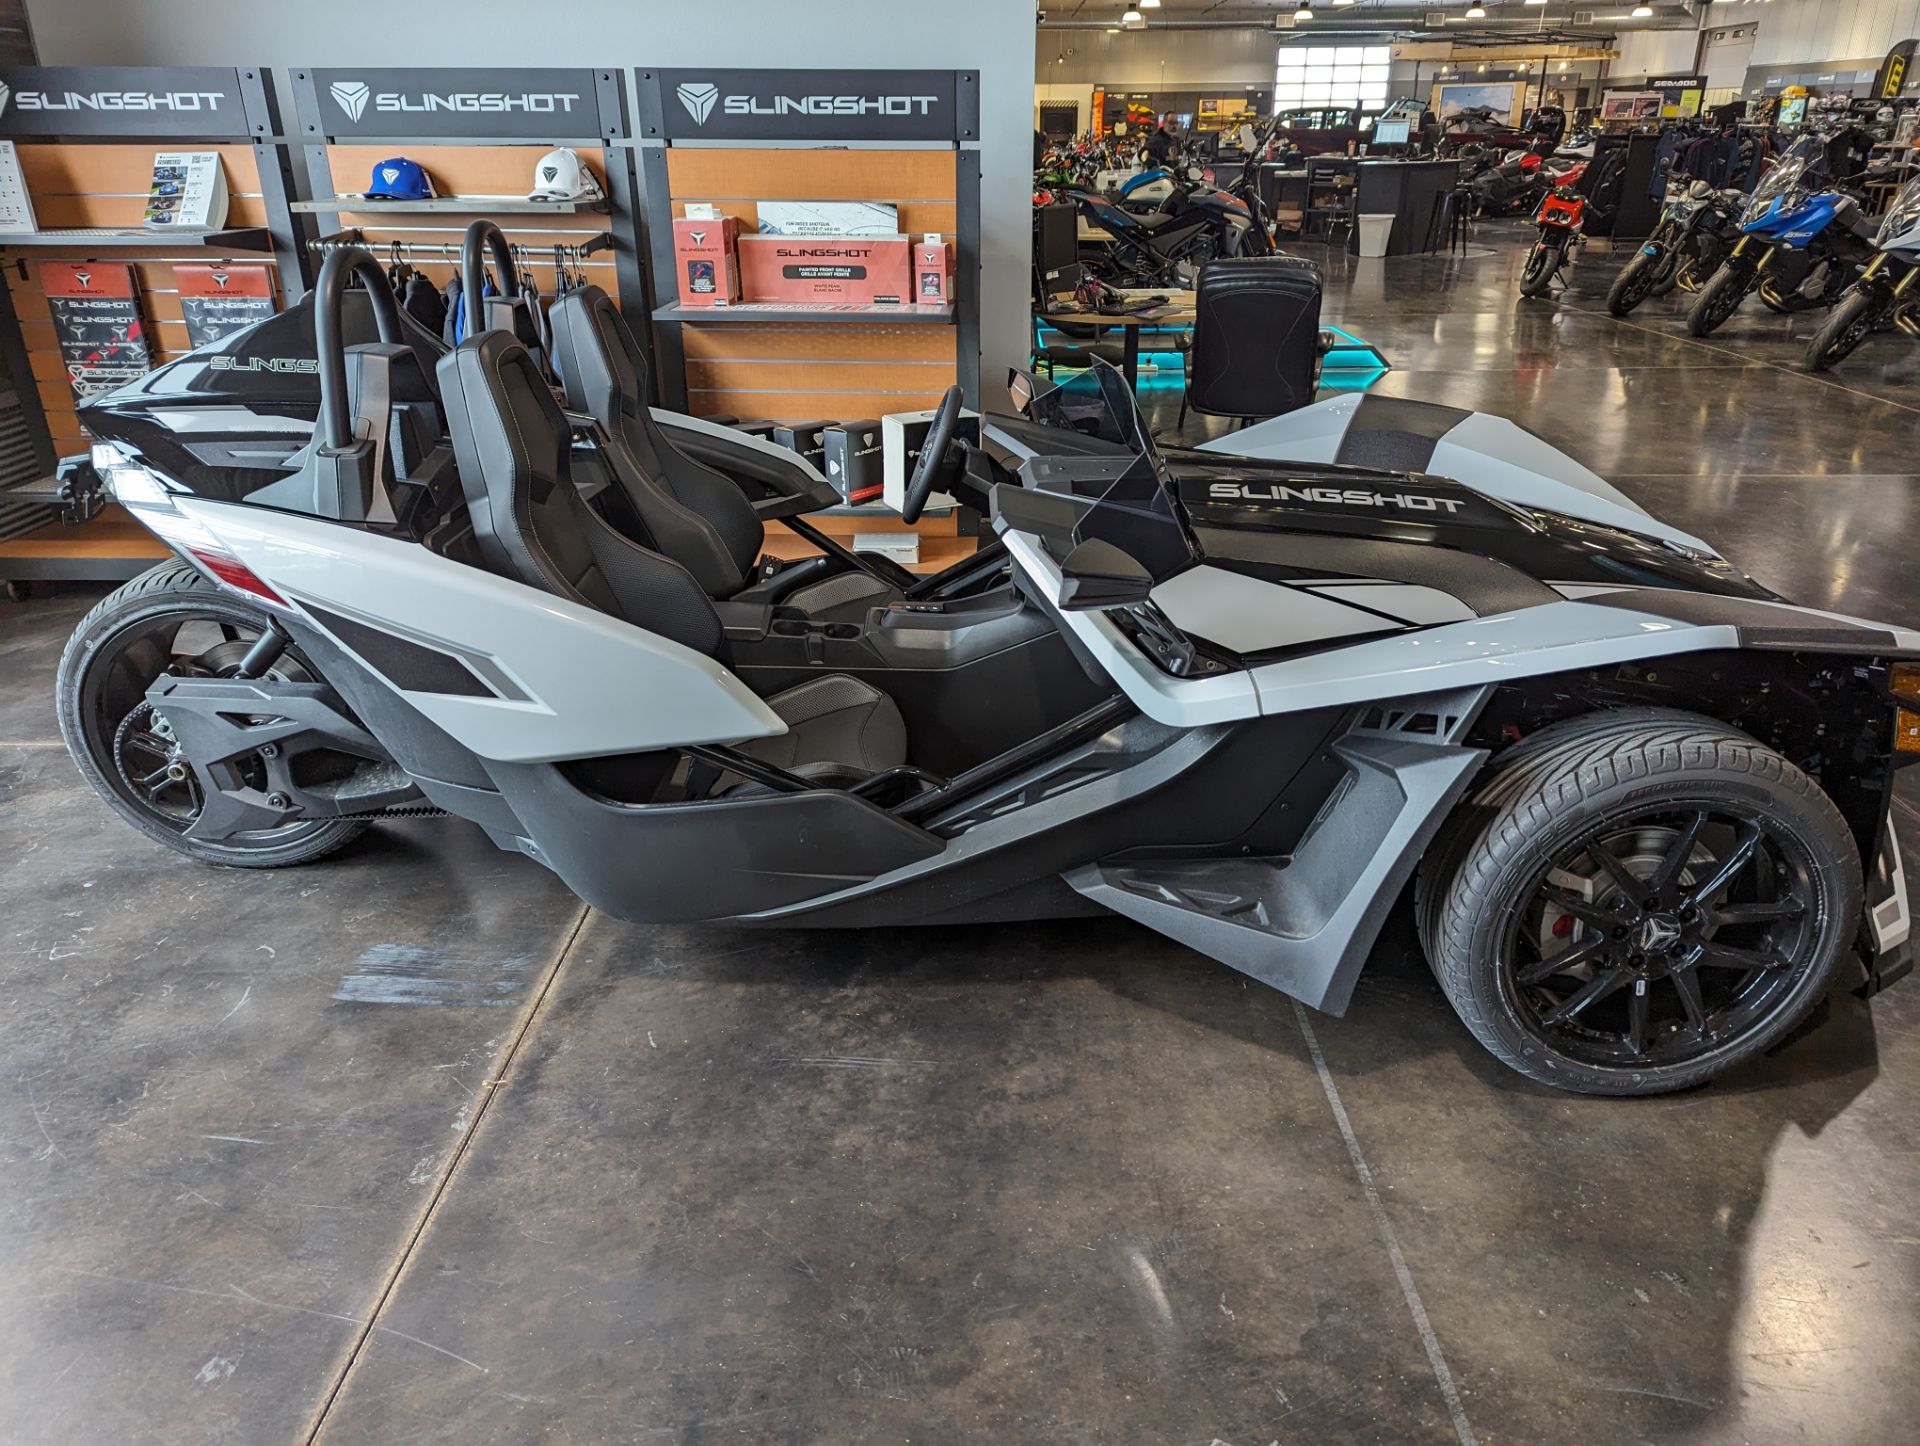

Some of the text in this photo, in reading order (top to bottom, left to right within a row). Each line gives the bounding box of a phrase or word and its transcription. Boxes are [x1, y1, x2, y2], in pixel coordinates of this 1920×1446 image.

[15, 92, 225, 110] SLINGSHOT
[376, 93, 580, 112] SLINGSHOT
[724, 95, 938, 115] SLINGSHOT
[777, 249, 872, 258] SLINGSHOT
[69, 301, 130, 309] SLINGSHOT
[211, 356, 320, 373] SLINGS
[1210, 483, 1467, 512] SLINGSHOT
